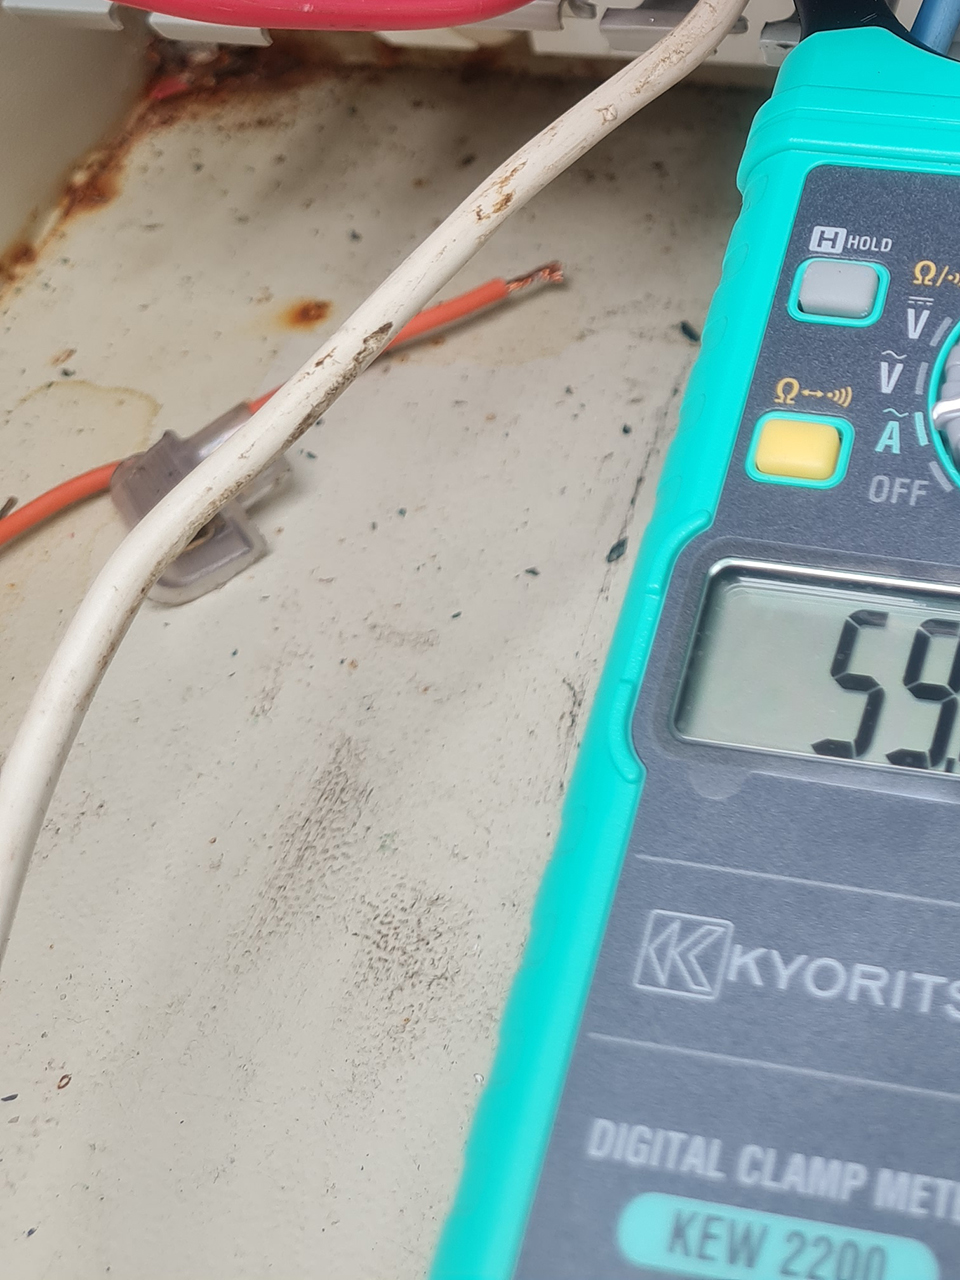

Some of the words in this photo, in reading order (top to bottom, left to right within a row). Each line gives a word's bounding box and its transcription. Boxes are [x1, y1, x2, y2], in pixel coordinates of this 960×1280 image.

[846, 235, 893, 253] HOLD
[874, 420, 901, 454] A
[868, 474, 929, 507] OFF
[587, 1117, 727, 1182] DIGITAL
[734, 1144, 869, 1203] CLAMP
[666, 1207, 769, 1269] KEW
[780, 1231, 888, 1280] 2200
